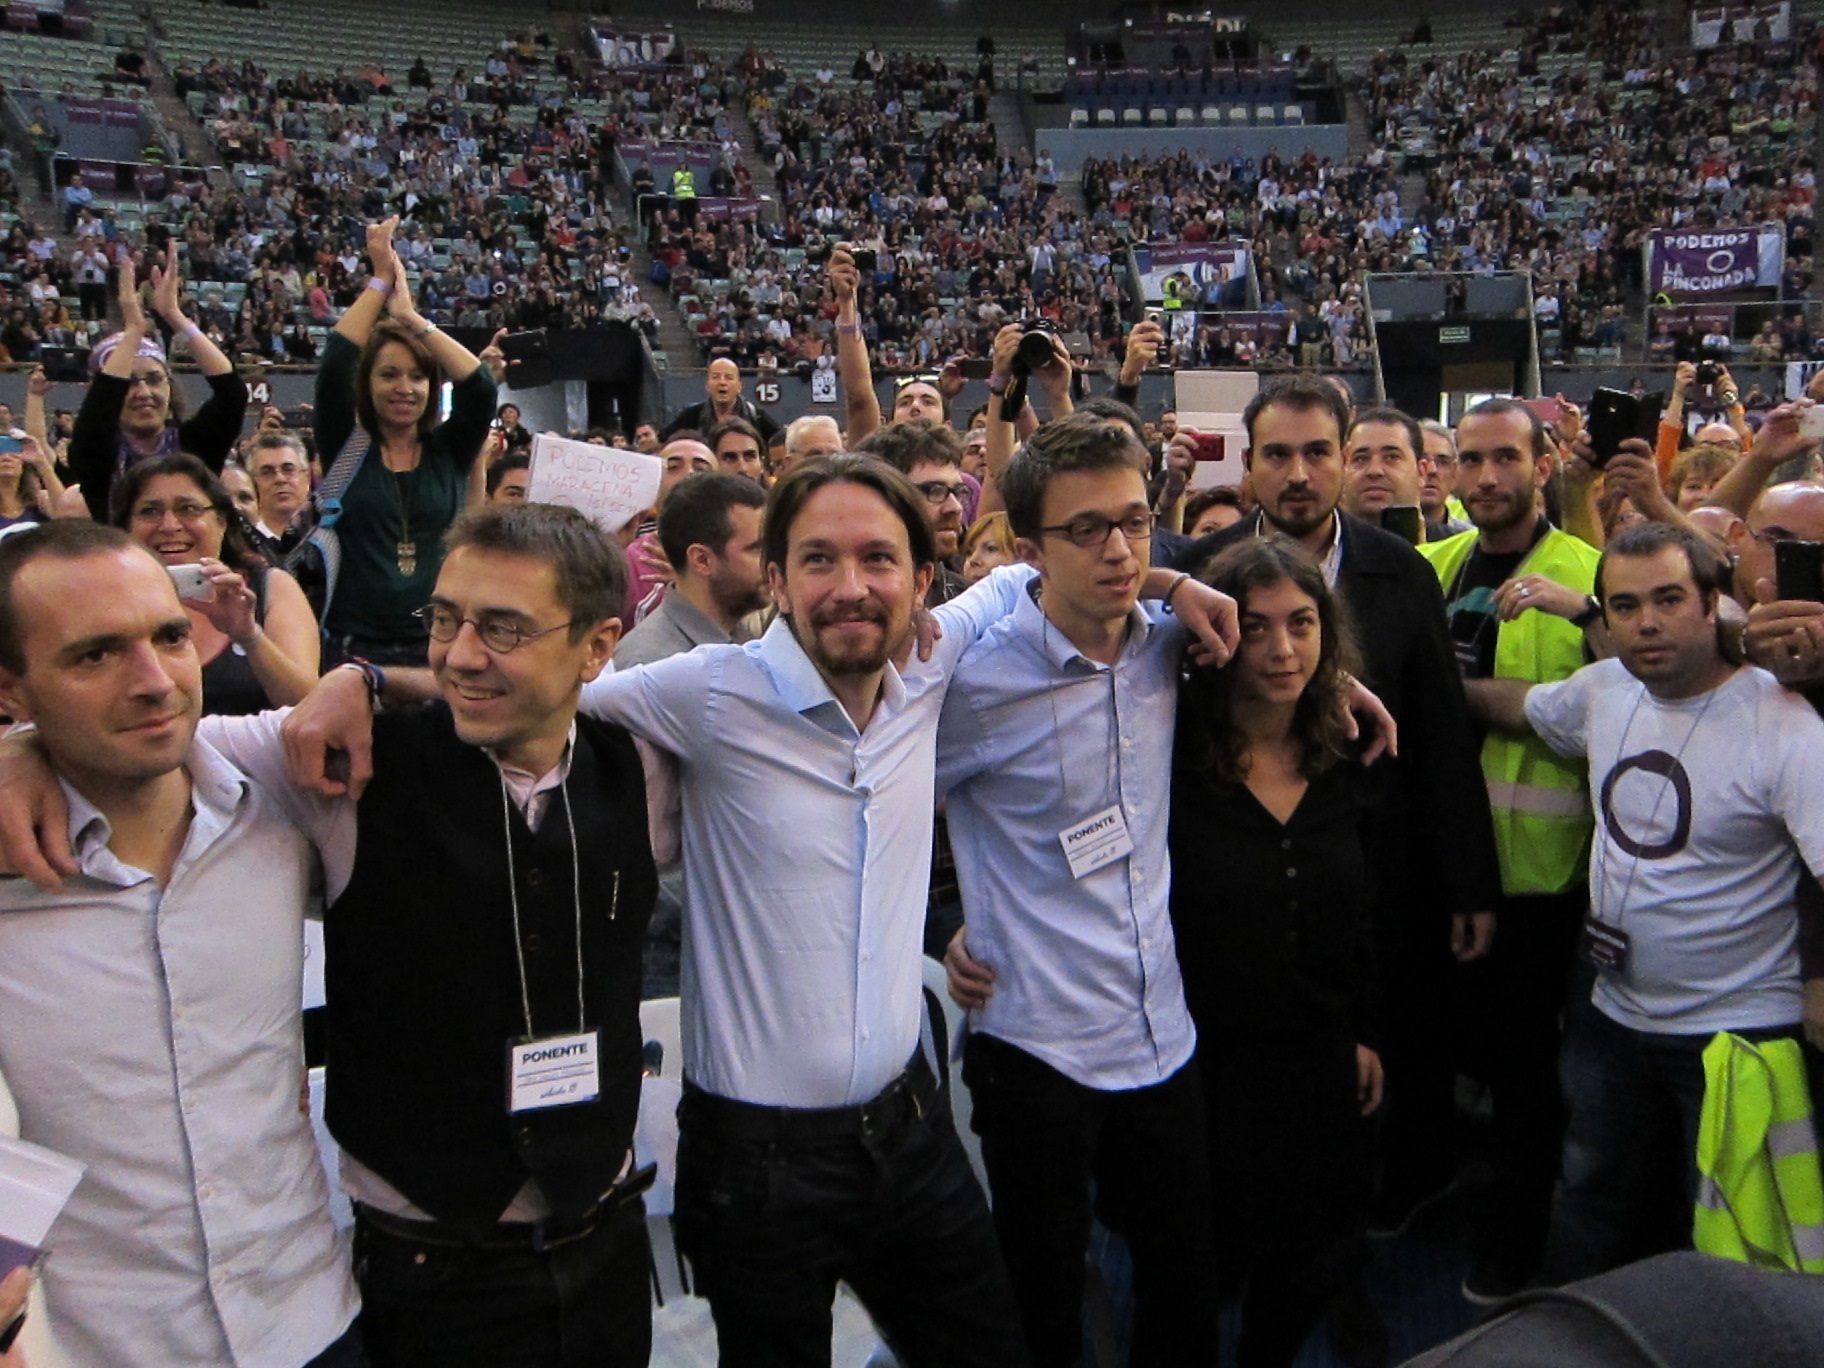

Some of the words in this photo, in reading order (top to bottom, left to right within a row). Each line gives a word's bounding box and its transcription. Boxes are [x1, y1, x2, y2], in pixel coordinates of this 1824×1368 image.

[1663, 232, 1750, 249] PODEMOS
[1663, 261, 1684, 278] LA
[245, 382, 270, 403] 14
[755, 383, 780, 402] 15
[1067, 814, 1116, 844] PONENTE
[522, 1042, 588, 1065] PONENTE
